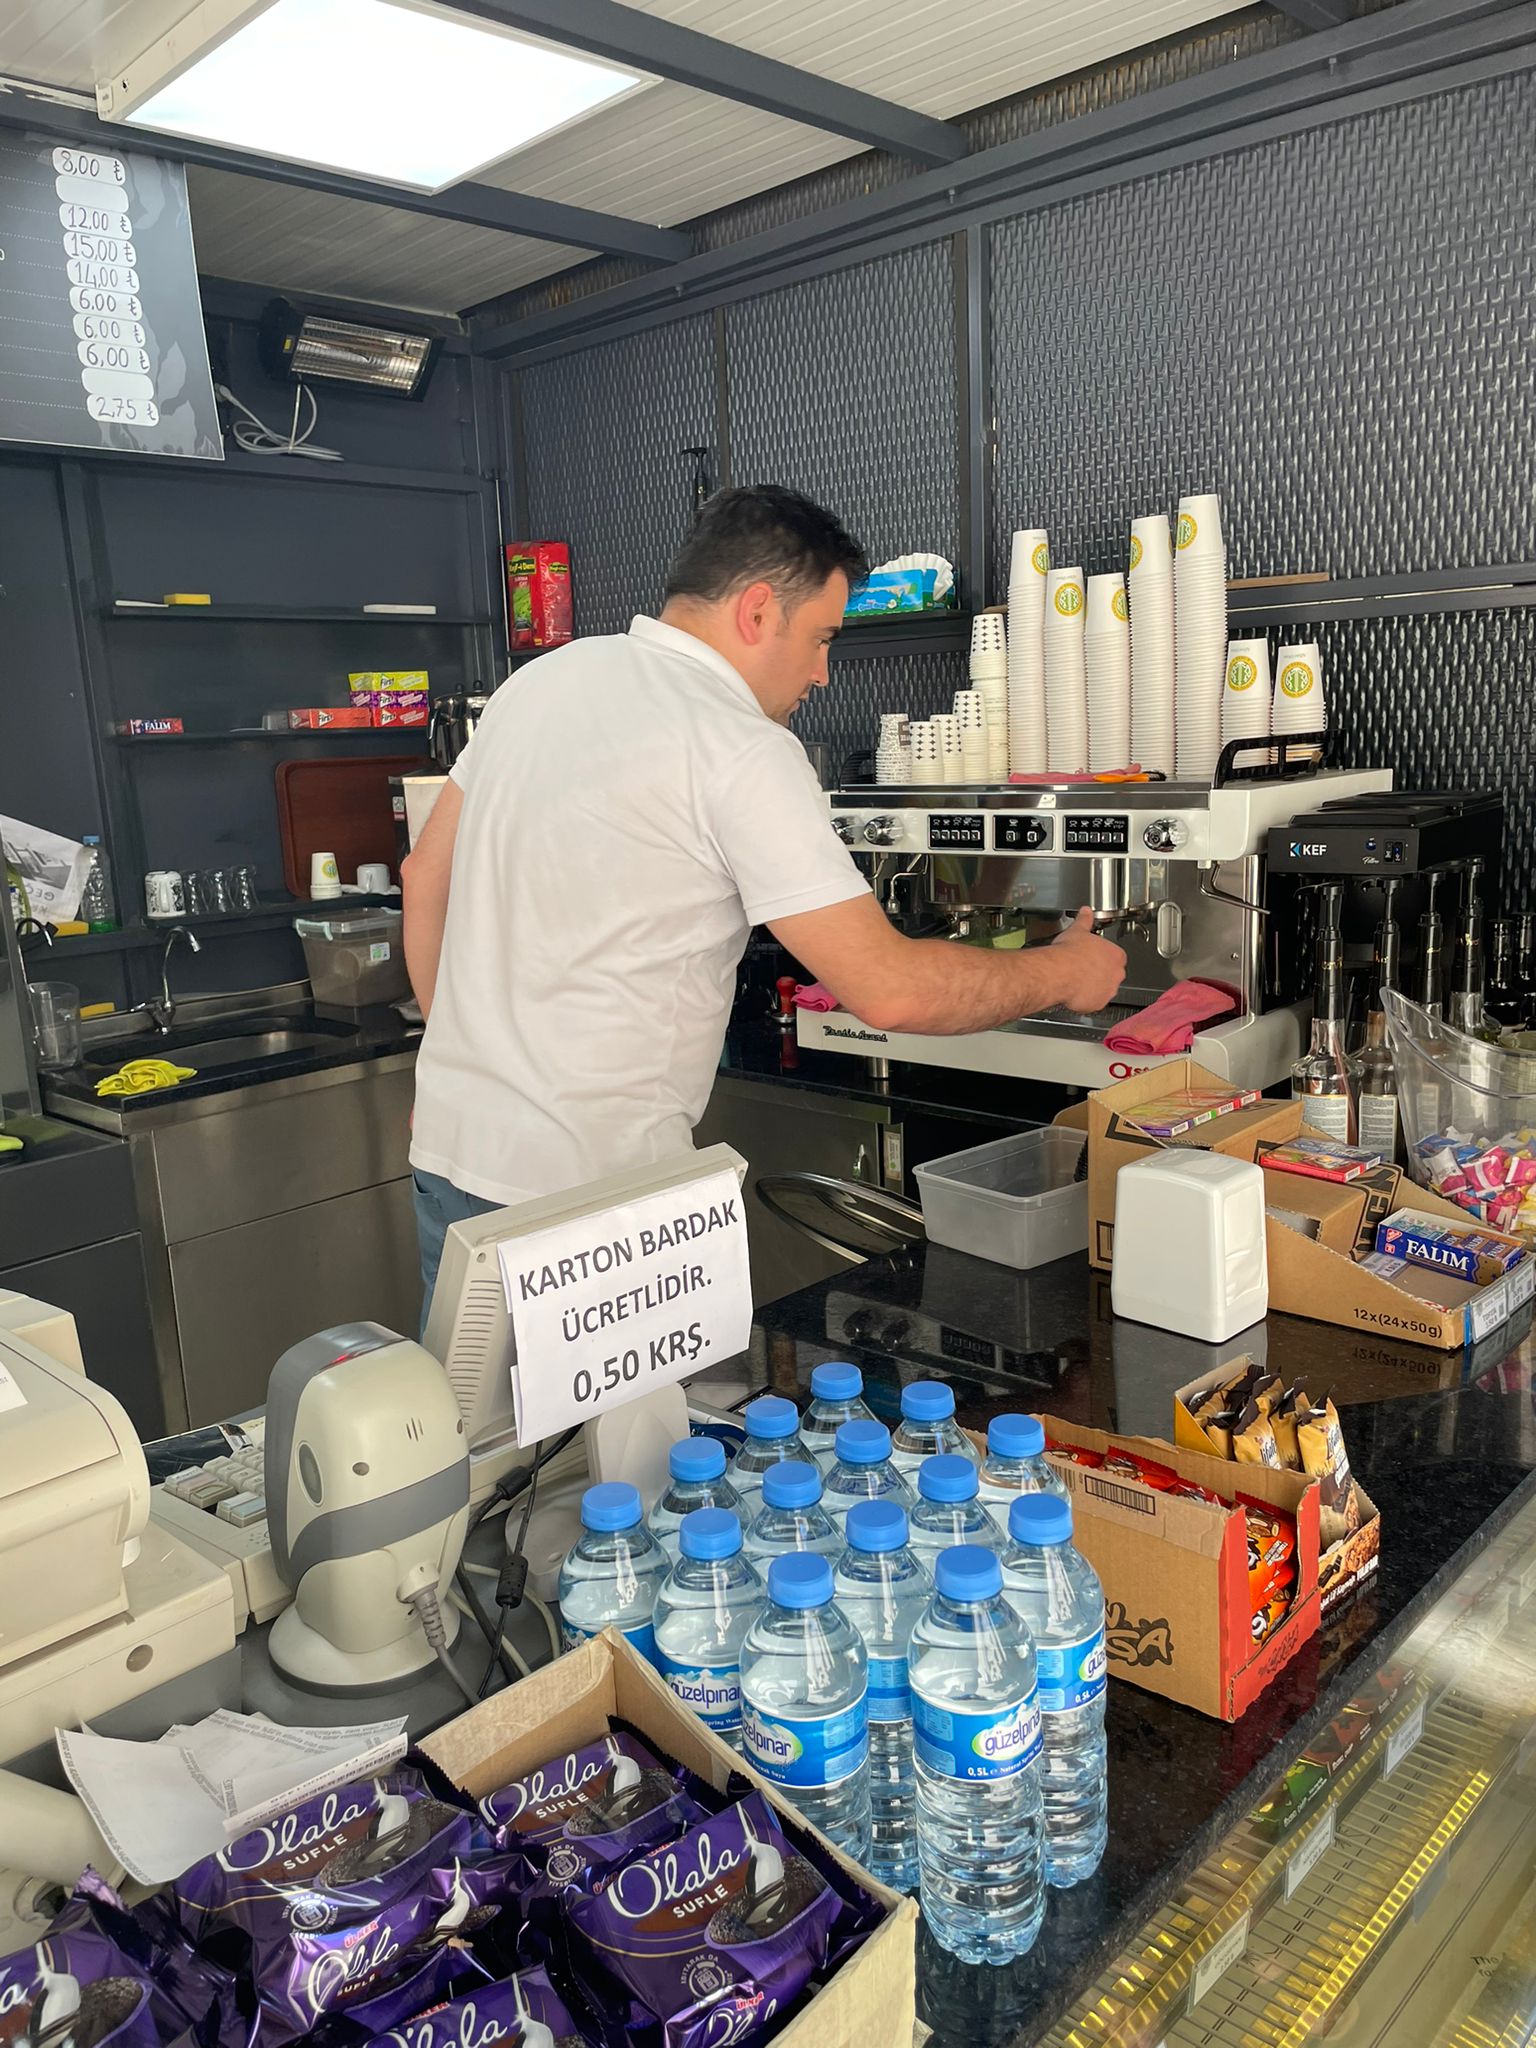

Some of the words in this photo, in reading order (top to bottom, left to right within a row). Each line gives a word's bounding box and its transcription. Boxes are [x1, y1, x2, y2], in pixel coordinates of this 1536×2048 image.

[61, 150, 100, 177] 8,00
[71, 234, 118, 262] 15,00
[83, 316, 120, 339] 6,00
[86, 343, 129, 369] 6,00
[96, 396, 136, 420] 2,75
[144, 721, 171, 731] FALIM
[1303, 844, 1327, 856] KEF
[519, 1237, 632, 1301] KARTON
[639, 1199, 738, 1257] BARDAK
[1406, 1238, 1470, 1272] FALIM
[562, 1264, 712, 1342] ÜCRETLİDİR.
[1353, 1308, 1443, 1339] 12x(24x50g)
[573, 1349, 640, 1403] 0,50
[649, 1322, 711, 1371] KRŞ.
[479, 1753, 603, 1826] O'lala
[535, 1792, 590, 1819] SUFLE
[215, 1793, 368, 1873] O'lala
[283, 1832, 348, 1871] SUFLE
[607, 1832, 741, 1919] O'lala
[672, 1883, 729, 1919] SUFLE
